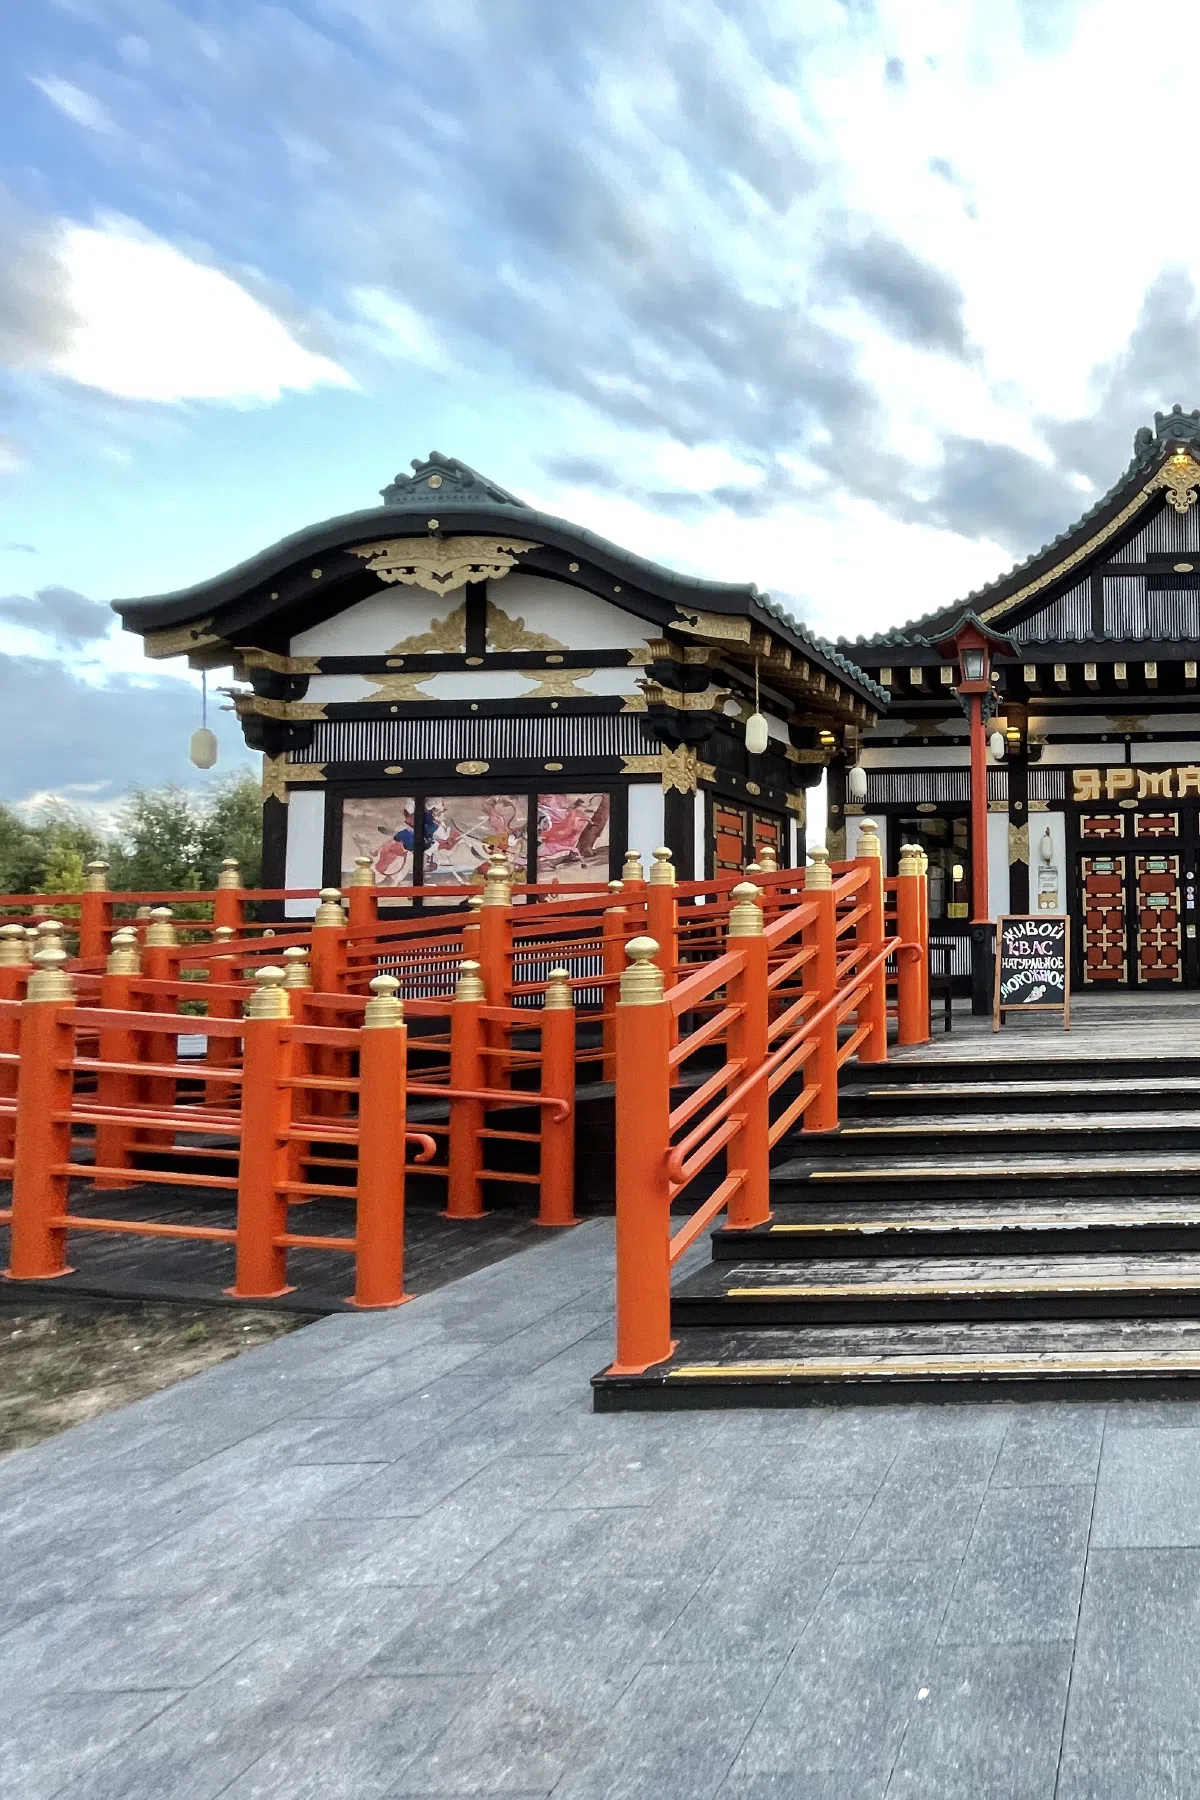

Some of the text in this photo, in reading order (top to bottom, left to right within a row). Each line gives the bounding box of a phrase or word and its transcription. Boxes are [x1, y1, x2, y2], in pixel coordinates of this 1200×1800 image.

[1003, 921, 1064, 944] ЖИВОЙ
[1008, 940, 1053, 956] КВАС
[1000, 969, 1065, 999] МОРОЖЕНОЕ
